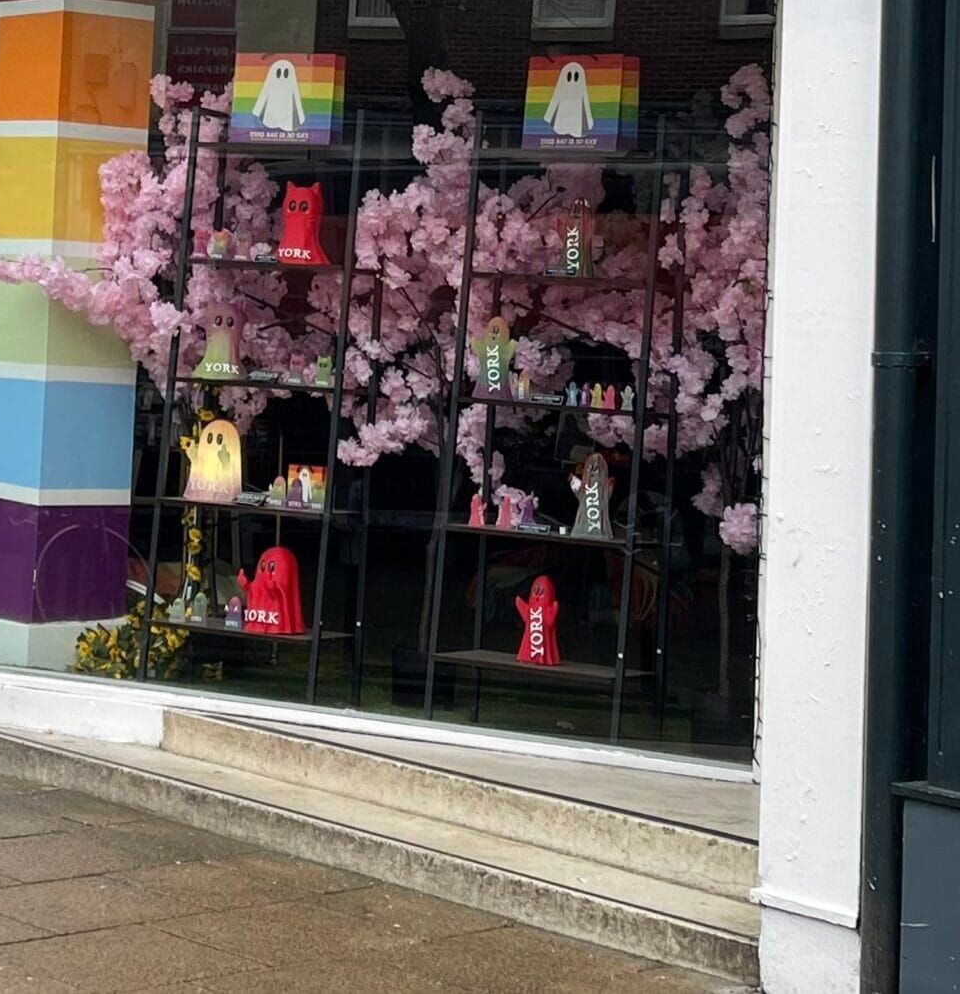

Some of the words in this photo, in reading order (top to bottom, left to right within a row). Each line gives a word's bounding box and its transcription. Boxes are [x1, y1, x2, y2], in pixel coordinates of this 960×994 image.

[278, 247, 311, 260] YORK
[567, 226, 580, 270] YORK
[205, 362, 240, 375] YORK
[487, 344, 501, 392] YORK
[190, 478, 229, 494] YORK
[585, 482, 601, 532] YORK
[530, 606, 544, 658] YORK
